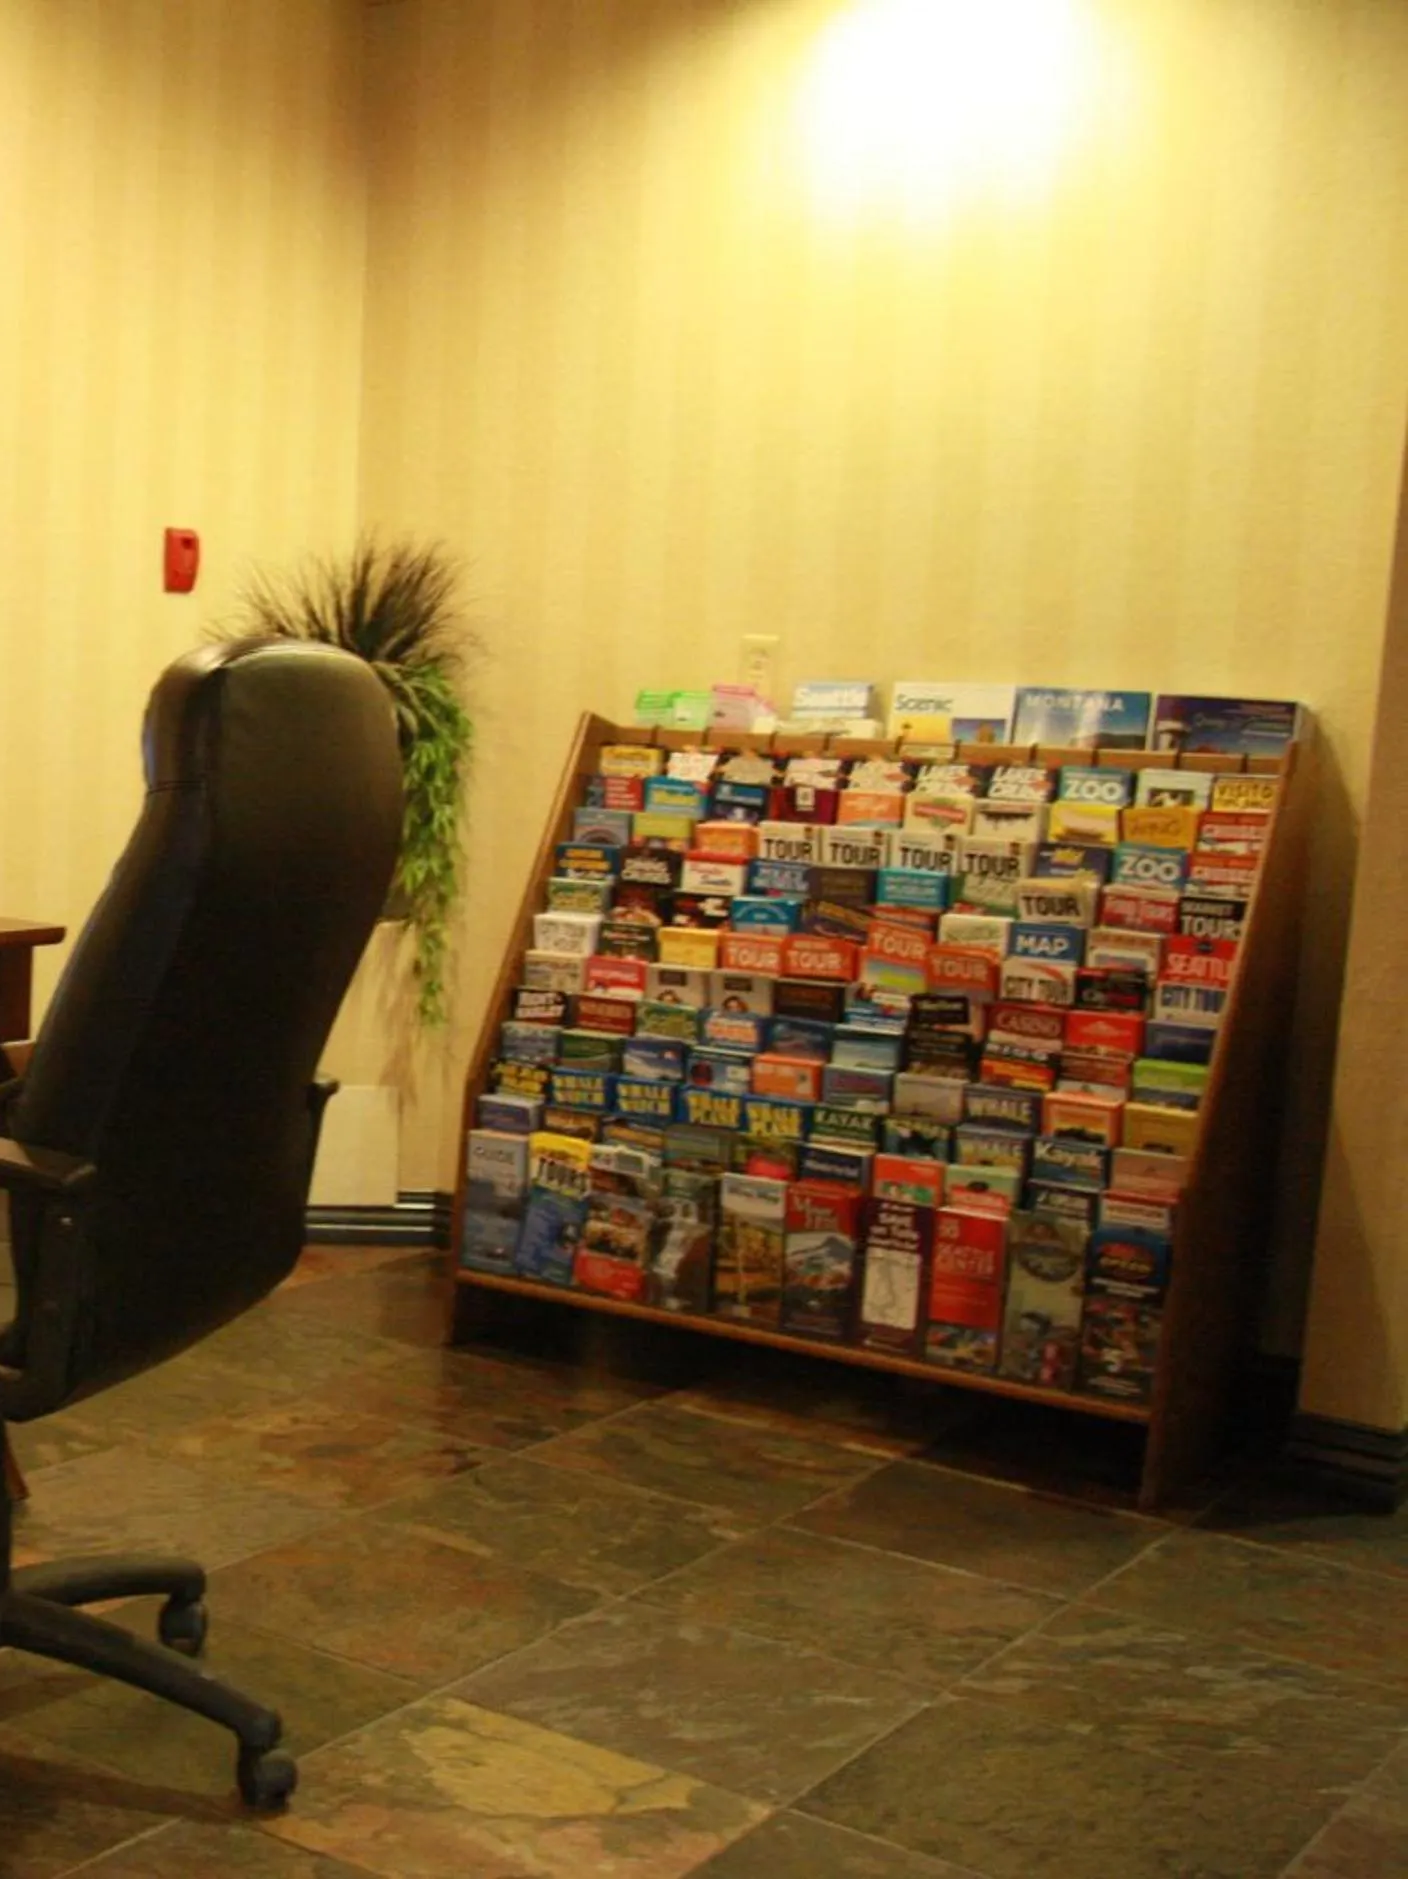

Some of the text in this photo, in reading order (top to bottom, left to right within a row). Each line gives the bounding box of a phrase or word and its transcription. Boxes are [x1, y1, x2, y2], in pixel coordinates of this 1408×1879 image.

[1066, 779, 1124, 801] ZOO
[1217, 782, 1274, 800] VISITO
[763, 838, 813, 860] TOUR
[829, 842, 881, 865] TOUR
[899, 847, 954, 870] TOUR
[964, 853, 1020, 876] TOUR
[1119, 855, 1181, 882] ZOO
[1022, 895, 1081, 917] TOUR
[871, 932, 927, 961] TOUR
[1015, 934, 1071, 957] MAP
[728, 947, 780, 970] TOUR
[786, 950, 843, 971] TOUR
[931, 956, 989, 982] TOUR
[1168, 954, 1232, 978] SEATTL
[996, 1010, 1062, 1037] CASINO
